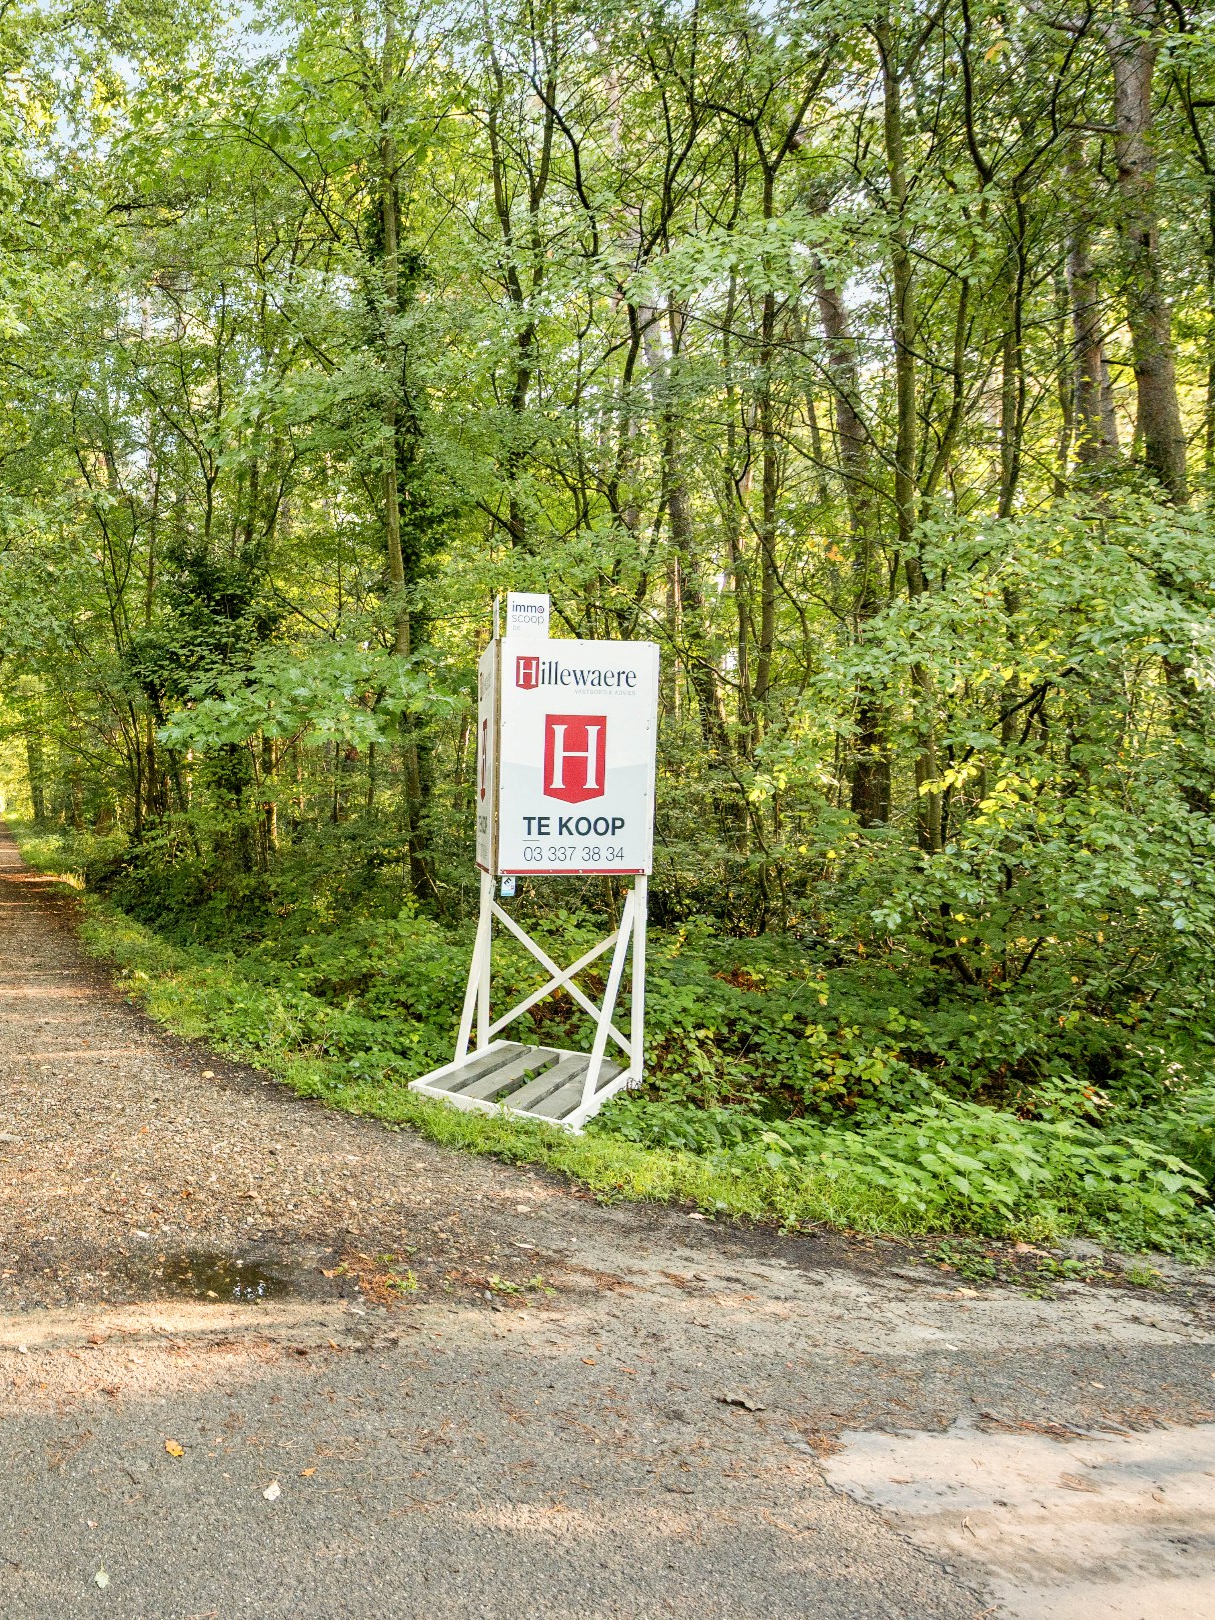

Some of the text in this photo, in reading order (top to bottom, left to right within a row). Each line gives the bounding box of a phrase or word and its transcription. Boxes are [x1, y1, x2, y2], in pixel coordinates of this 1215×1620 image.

[512, 601, 545, 614] immo
[512, 615, 545, 626] scoop
[517, 659, 637, 688] Hillewaere
[549, 724, 602, 789] H
[522, 816, 625, 836] TE KOOP
[523, 846, 625, 862] 03 337 38 34
